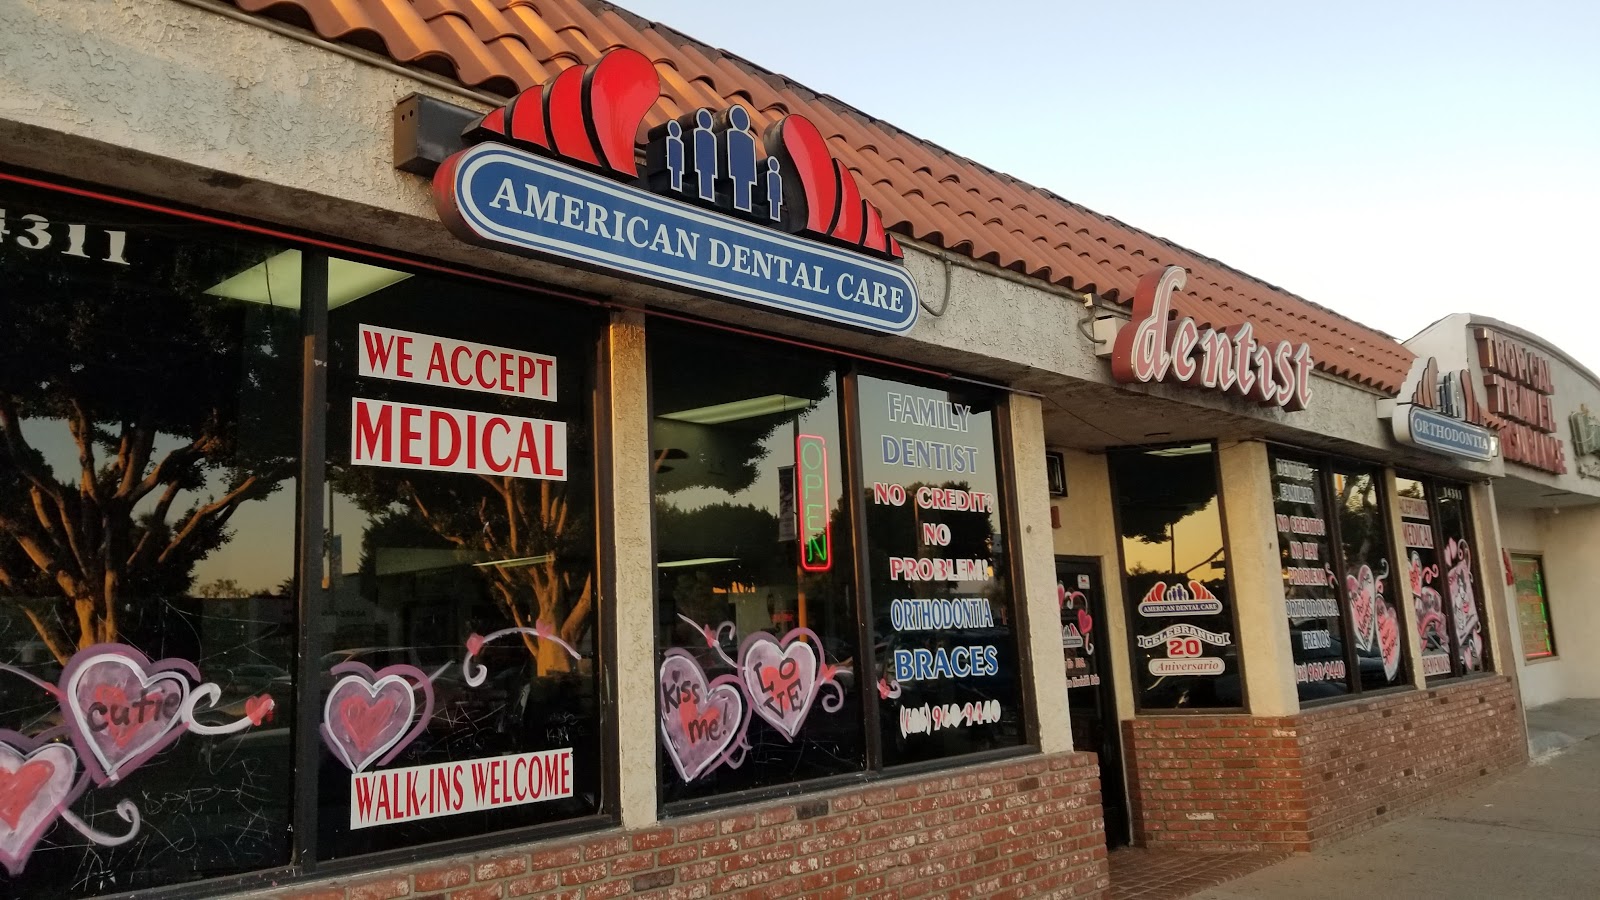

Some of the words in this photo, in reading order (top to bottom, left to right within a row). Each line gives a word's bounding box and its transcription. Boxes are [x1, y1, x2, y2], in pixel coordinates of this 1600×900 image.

[489, 177, 700, 261] AMERICAN
[708, 237, 830, 295] DENTAL
[837, 272, 904, 313] CARE
[1130, 265, 1315, 410] dentist
[362, 330, 413, 379] WE
[426, 341, 553, 397] ACCEPT
[887, 391, 971, 433] FAMILY
[355, 401, 563, 477] MEDICAL
[1414, 417, 1489, 451] ORTHODONTIA
[880, 434, 978, 474] DENTIST
[802, 442, 827, 563] OPEN
[874, 482, 906, 507] NO
[917, 486, 995, 513] CREDIT?
[923, 523, 952, 547] NO
[1276, 513, 1290, 533] NO
[1289, 541, 1303, 560] NO
[889, 556, 989, 582] PROBLEM!
[891, 598, 995, 632] ORTHODONTIA
[1143, 604, 1176, 613] AMERICAN
[1176, 603, 1201, 612] DENTAL
[1201, 602, 1218, 611] CARE
[1143, 624, 1224, 647] CELEBRANDO
[1168, 639, 1200, 656] 20
[894, 645, 999, 682] BRACES
[1156, 660, 1219, 672] Aniversario
[86, 686, 181, 732] cutie
[355, 764, 464, 824] WALK-INS
[471, 752, 570, 807] WELCOME
